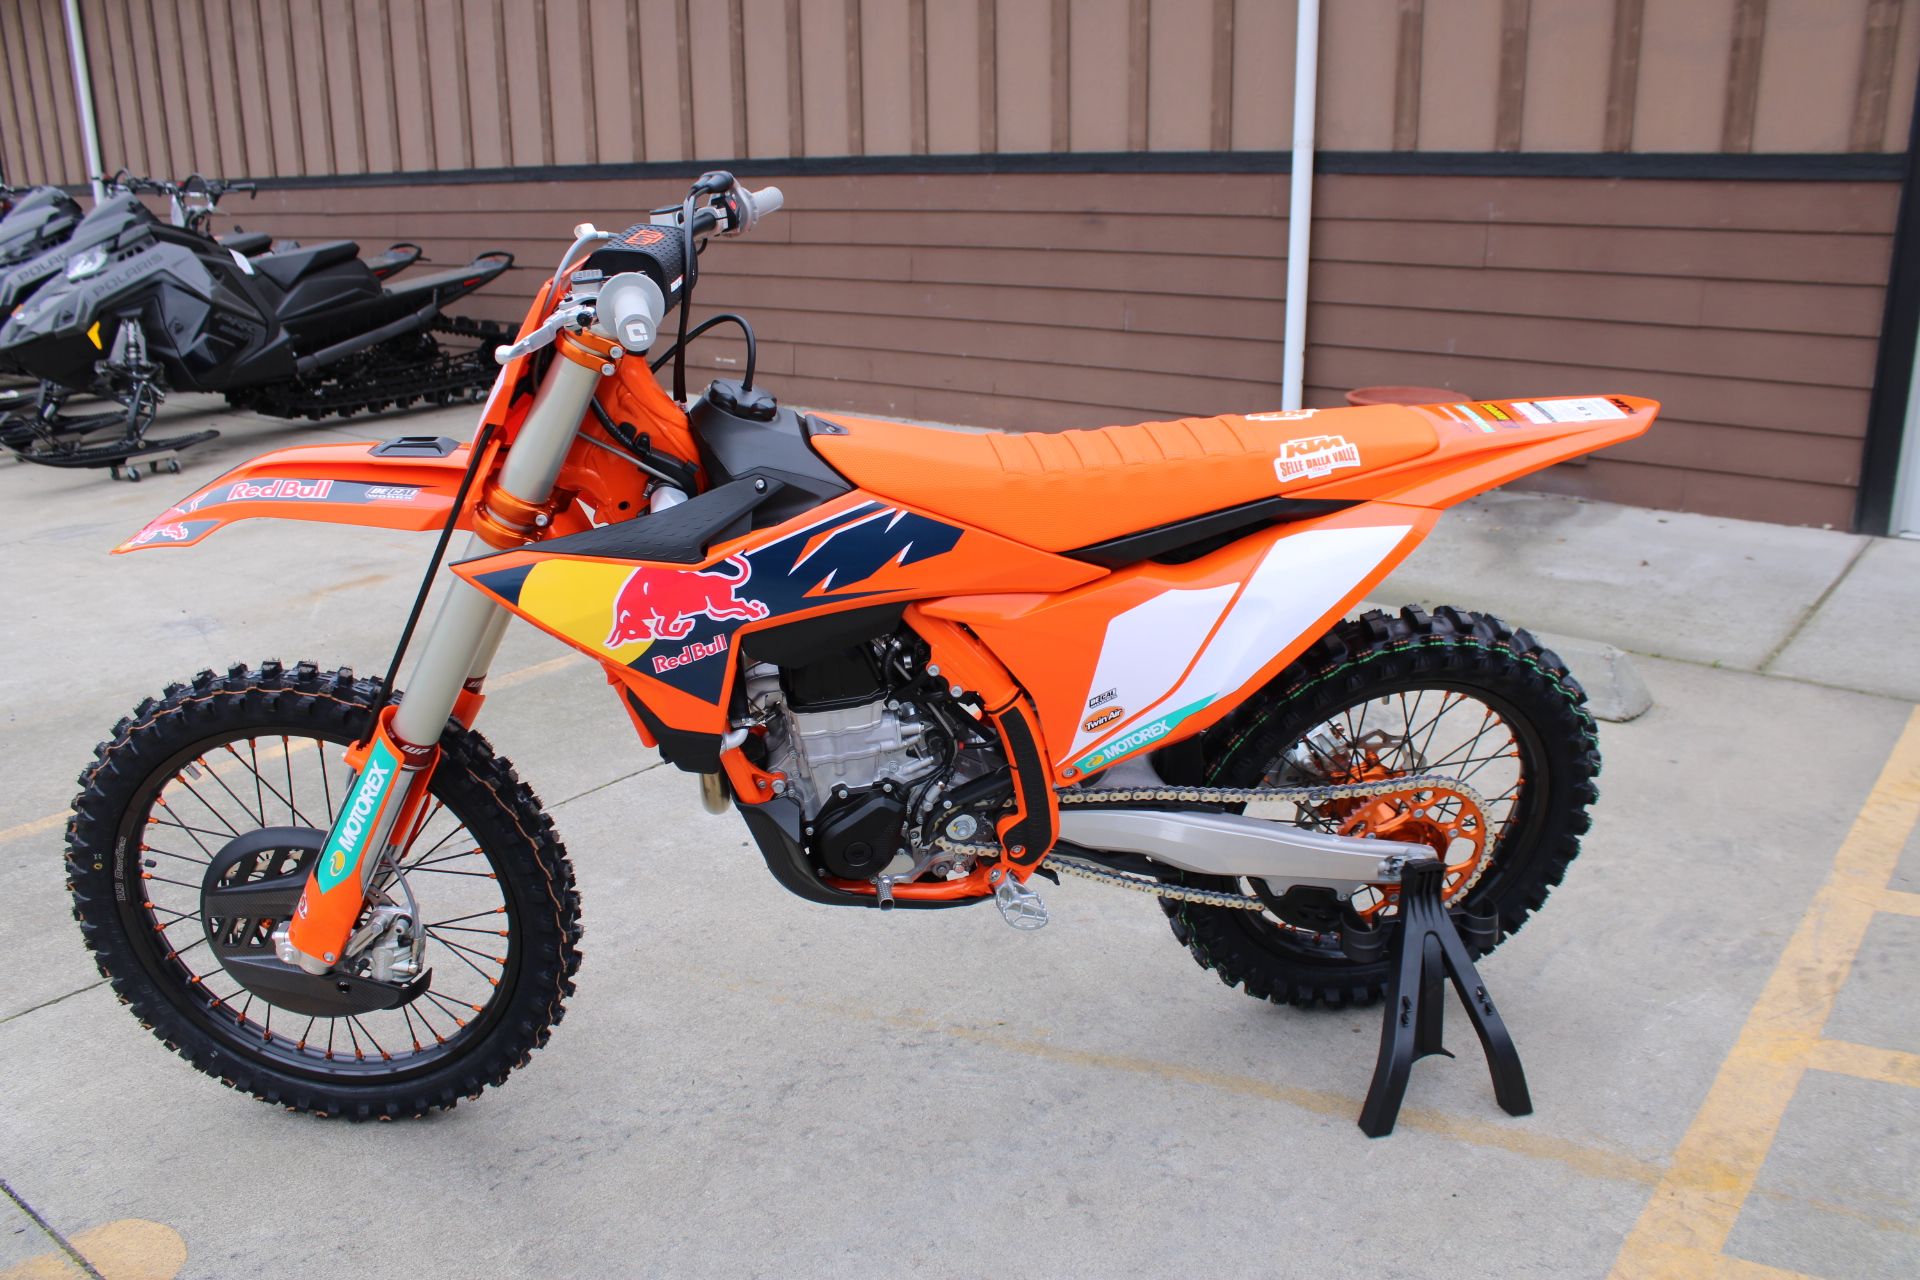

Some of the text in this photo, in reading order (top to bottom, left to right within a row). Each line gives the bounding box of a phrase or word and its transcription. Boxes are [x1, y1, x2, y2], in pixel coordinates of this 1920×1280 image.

[18, 253, 67, 282] POLA
[92, 252, 163, 297] POLARIS
[1279, 446, 1356, 477] SELLE DALLA VALLE
[1286, 437, 1343, 459] KTM
[226, 479, 334, 501] Red Bull
[652, 633, 728, 674] Red Bull
[1085, 708, 1123, 731] Twin Air
[1103, 720, 1172, 759] MOTOREX
[338, 759, 389, 853] MOTOREX
